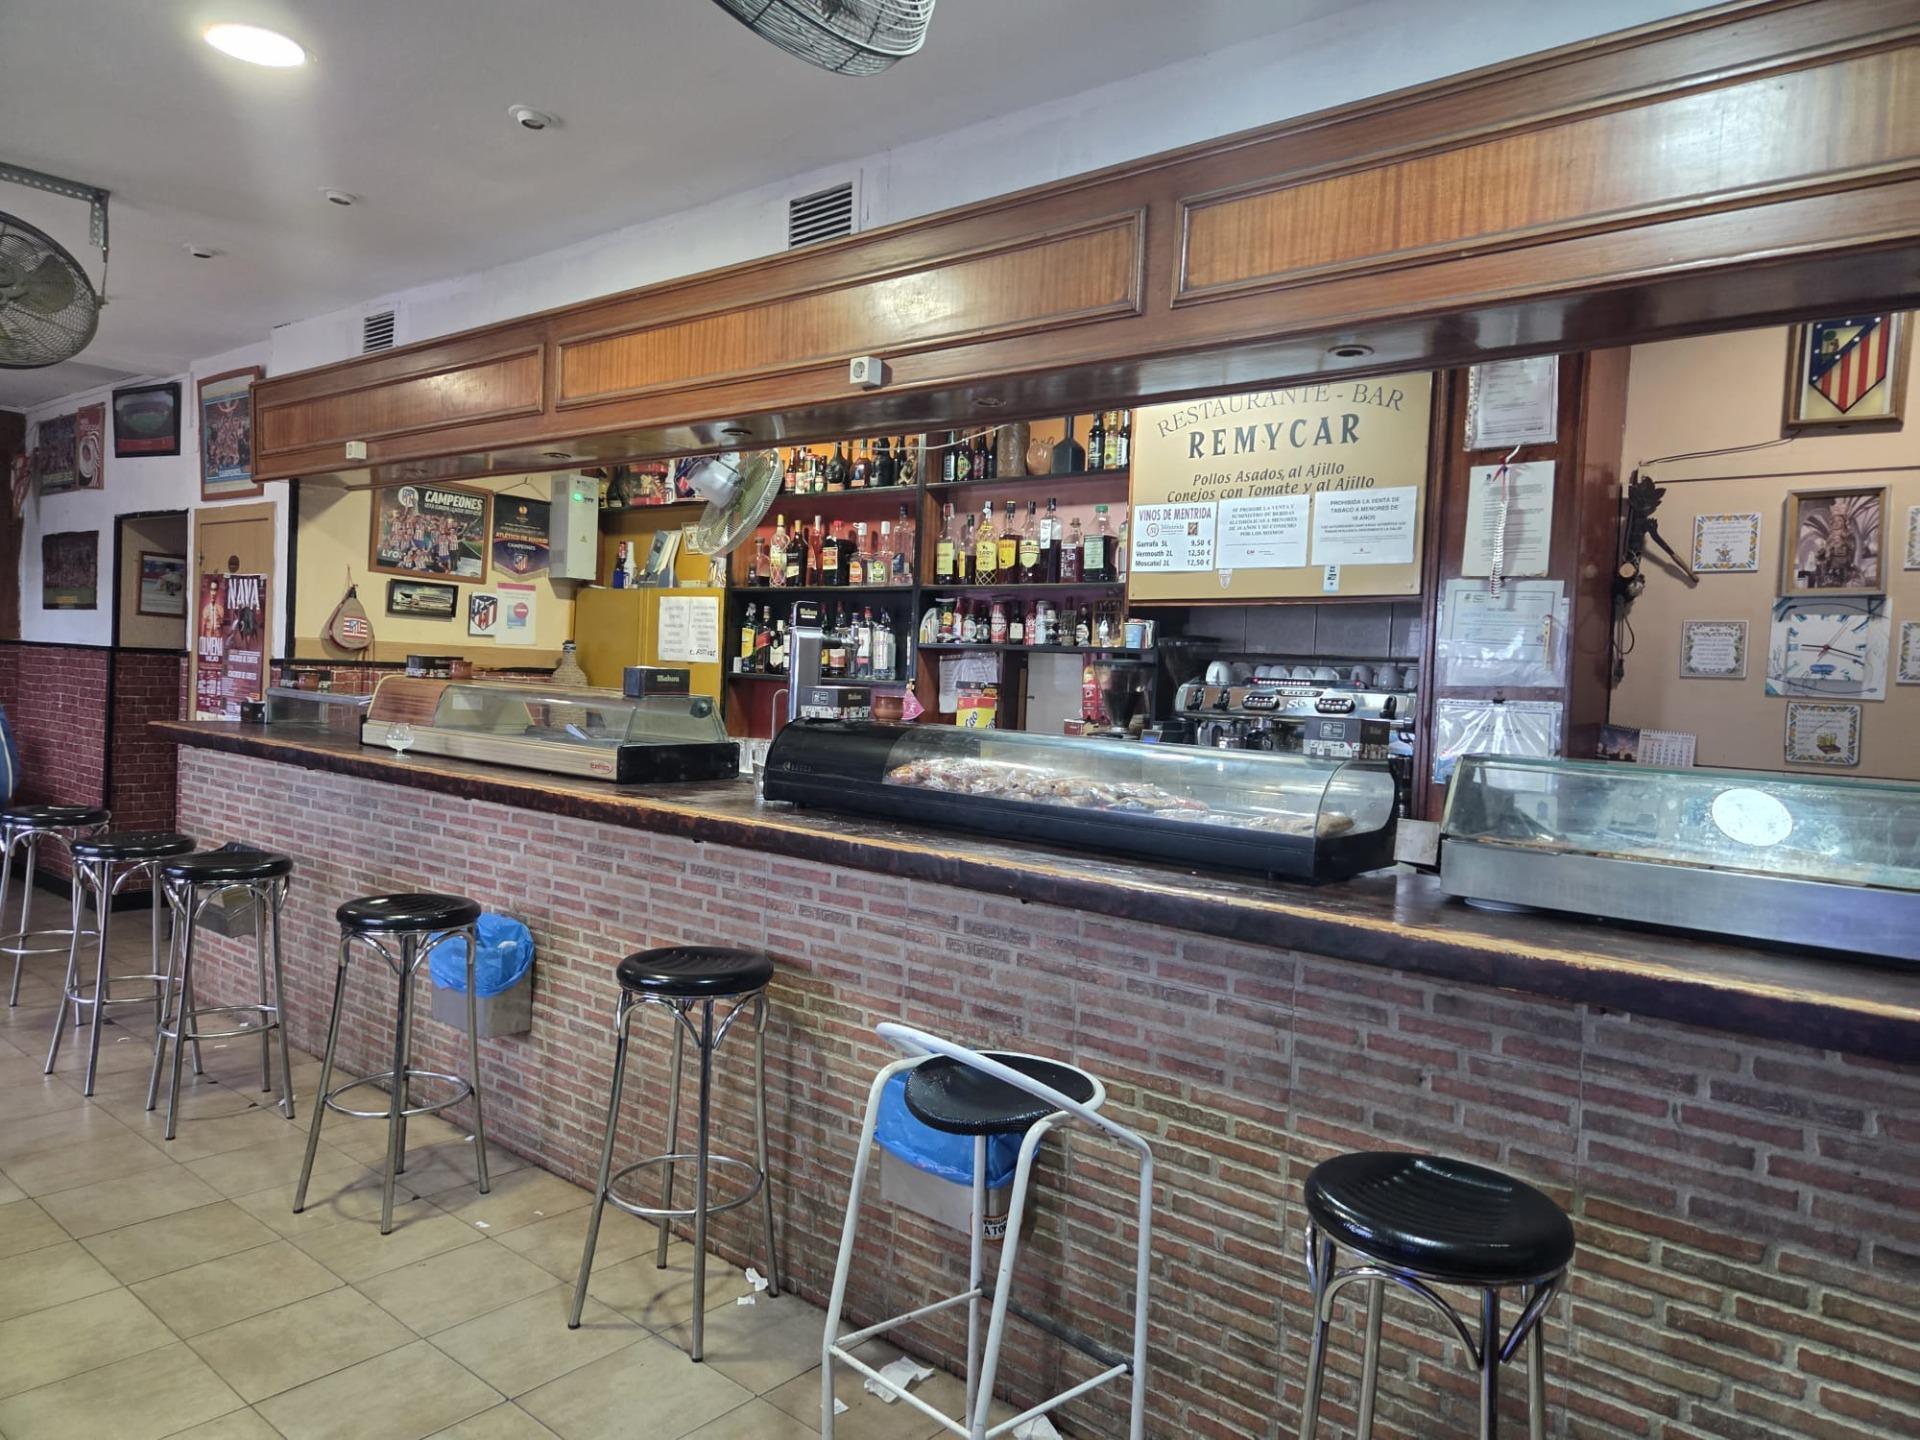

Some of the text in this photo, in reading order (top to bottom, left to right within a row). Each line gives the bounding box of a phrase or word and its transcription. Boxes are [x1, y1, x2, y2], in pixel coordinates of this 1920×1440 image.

[1156, 384, 1331, 438] RESTAURANTE
[1352, 383, 1404, 411] BAR
[1188, 413, 1360, 459] REMYCAR
[1193, 462, 1345, 486] Pollos Asados, al Ajillo
[425, 490, 483, 510] CAMPEONES
[1167, 476, 1375, 503] Conejos con Tomate y al Ajillo
[1139, 508, 1160, 521] VINOS
[1163, 508, 1172, 520] DE
[1135, 549, 1165, 558] Vermouth
[1188, 549, 1205, 557] 12,50
[1191, 539, 1205, 547] 9,50
[1187, 559, 1204, 567] 12,50
[227, 578, 260, 610] NAVA
